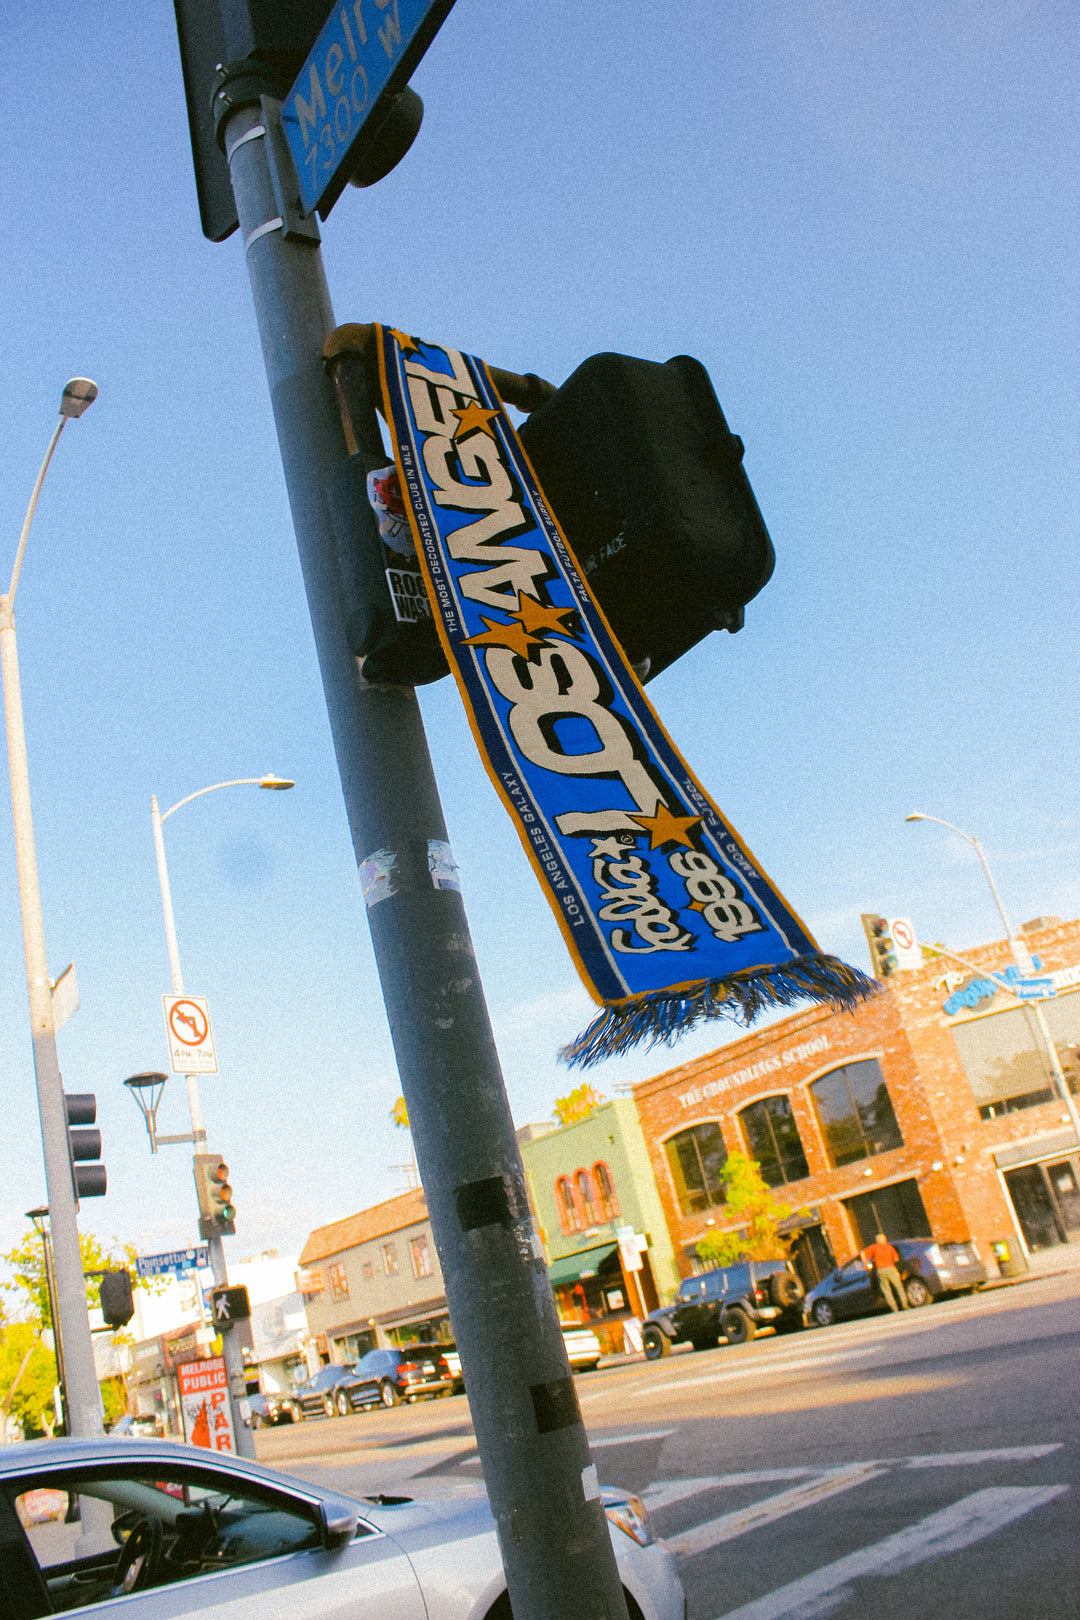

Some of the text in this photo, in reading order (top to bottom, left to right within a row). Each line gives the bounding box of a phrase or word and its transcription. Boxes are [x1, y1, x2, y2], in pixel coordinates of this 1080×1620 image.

[401, 444, 458, 632] THE MOST DECORATED CLUB IN MLS
[531, 490, 591, 603] FALTA FUTBOL SUPPLY
[484, 637, 669, 839] LOS
[501, 771, 585, 927] LOS ANGELES GALAXY
[726, 843, 761, 879] AMOR
[668, 850, 764, 943] 1996
[781, 1034, 832, 1066] SCHOOL
[180, 1357, 224, 1377] MELROSE
[182, 1371, 226, 1392] PUBLIC
